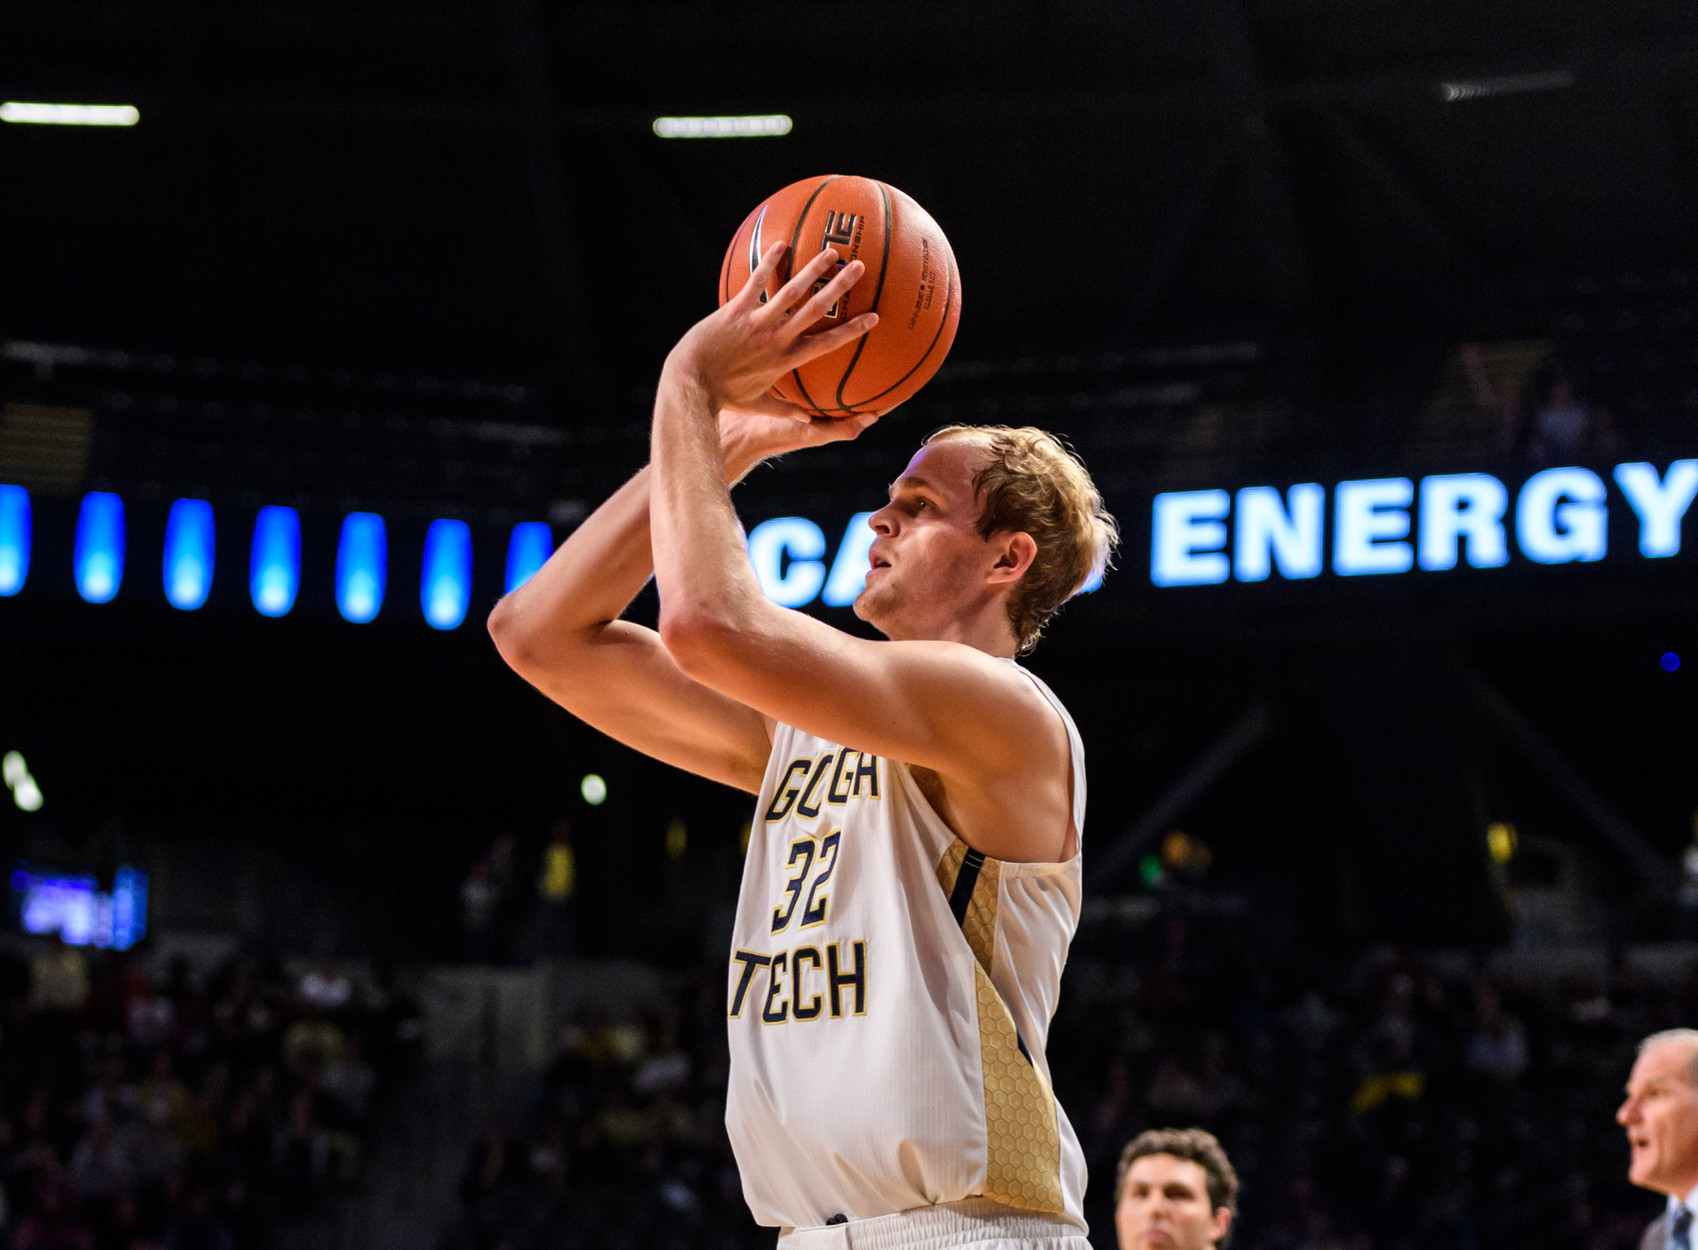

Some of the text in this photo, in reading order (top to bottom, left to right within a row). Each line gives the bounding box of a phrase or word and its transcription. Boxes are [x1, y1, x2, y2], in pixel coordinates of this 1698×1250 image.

[840, 215, 865, 320] CHAONSHIP
[1150, 458, 1698, 588] ENERGY
[770, 828, 842, 936] 32
[727, 940, 868, 1026] TECH
